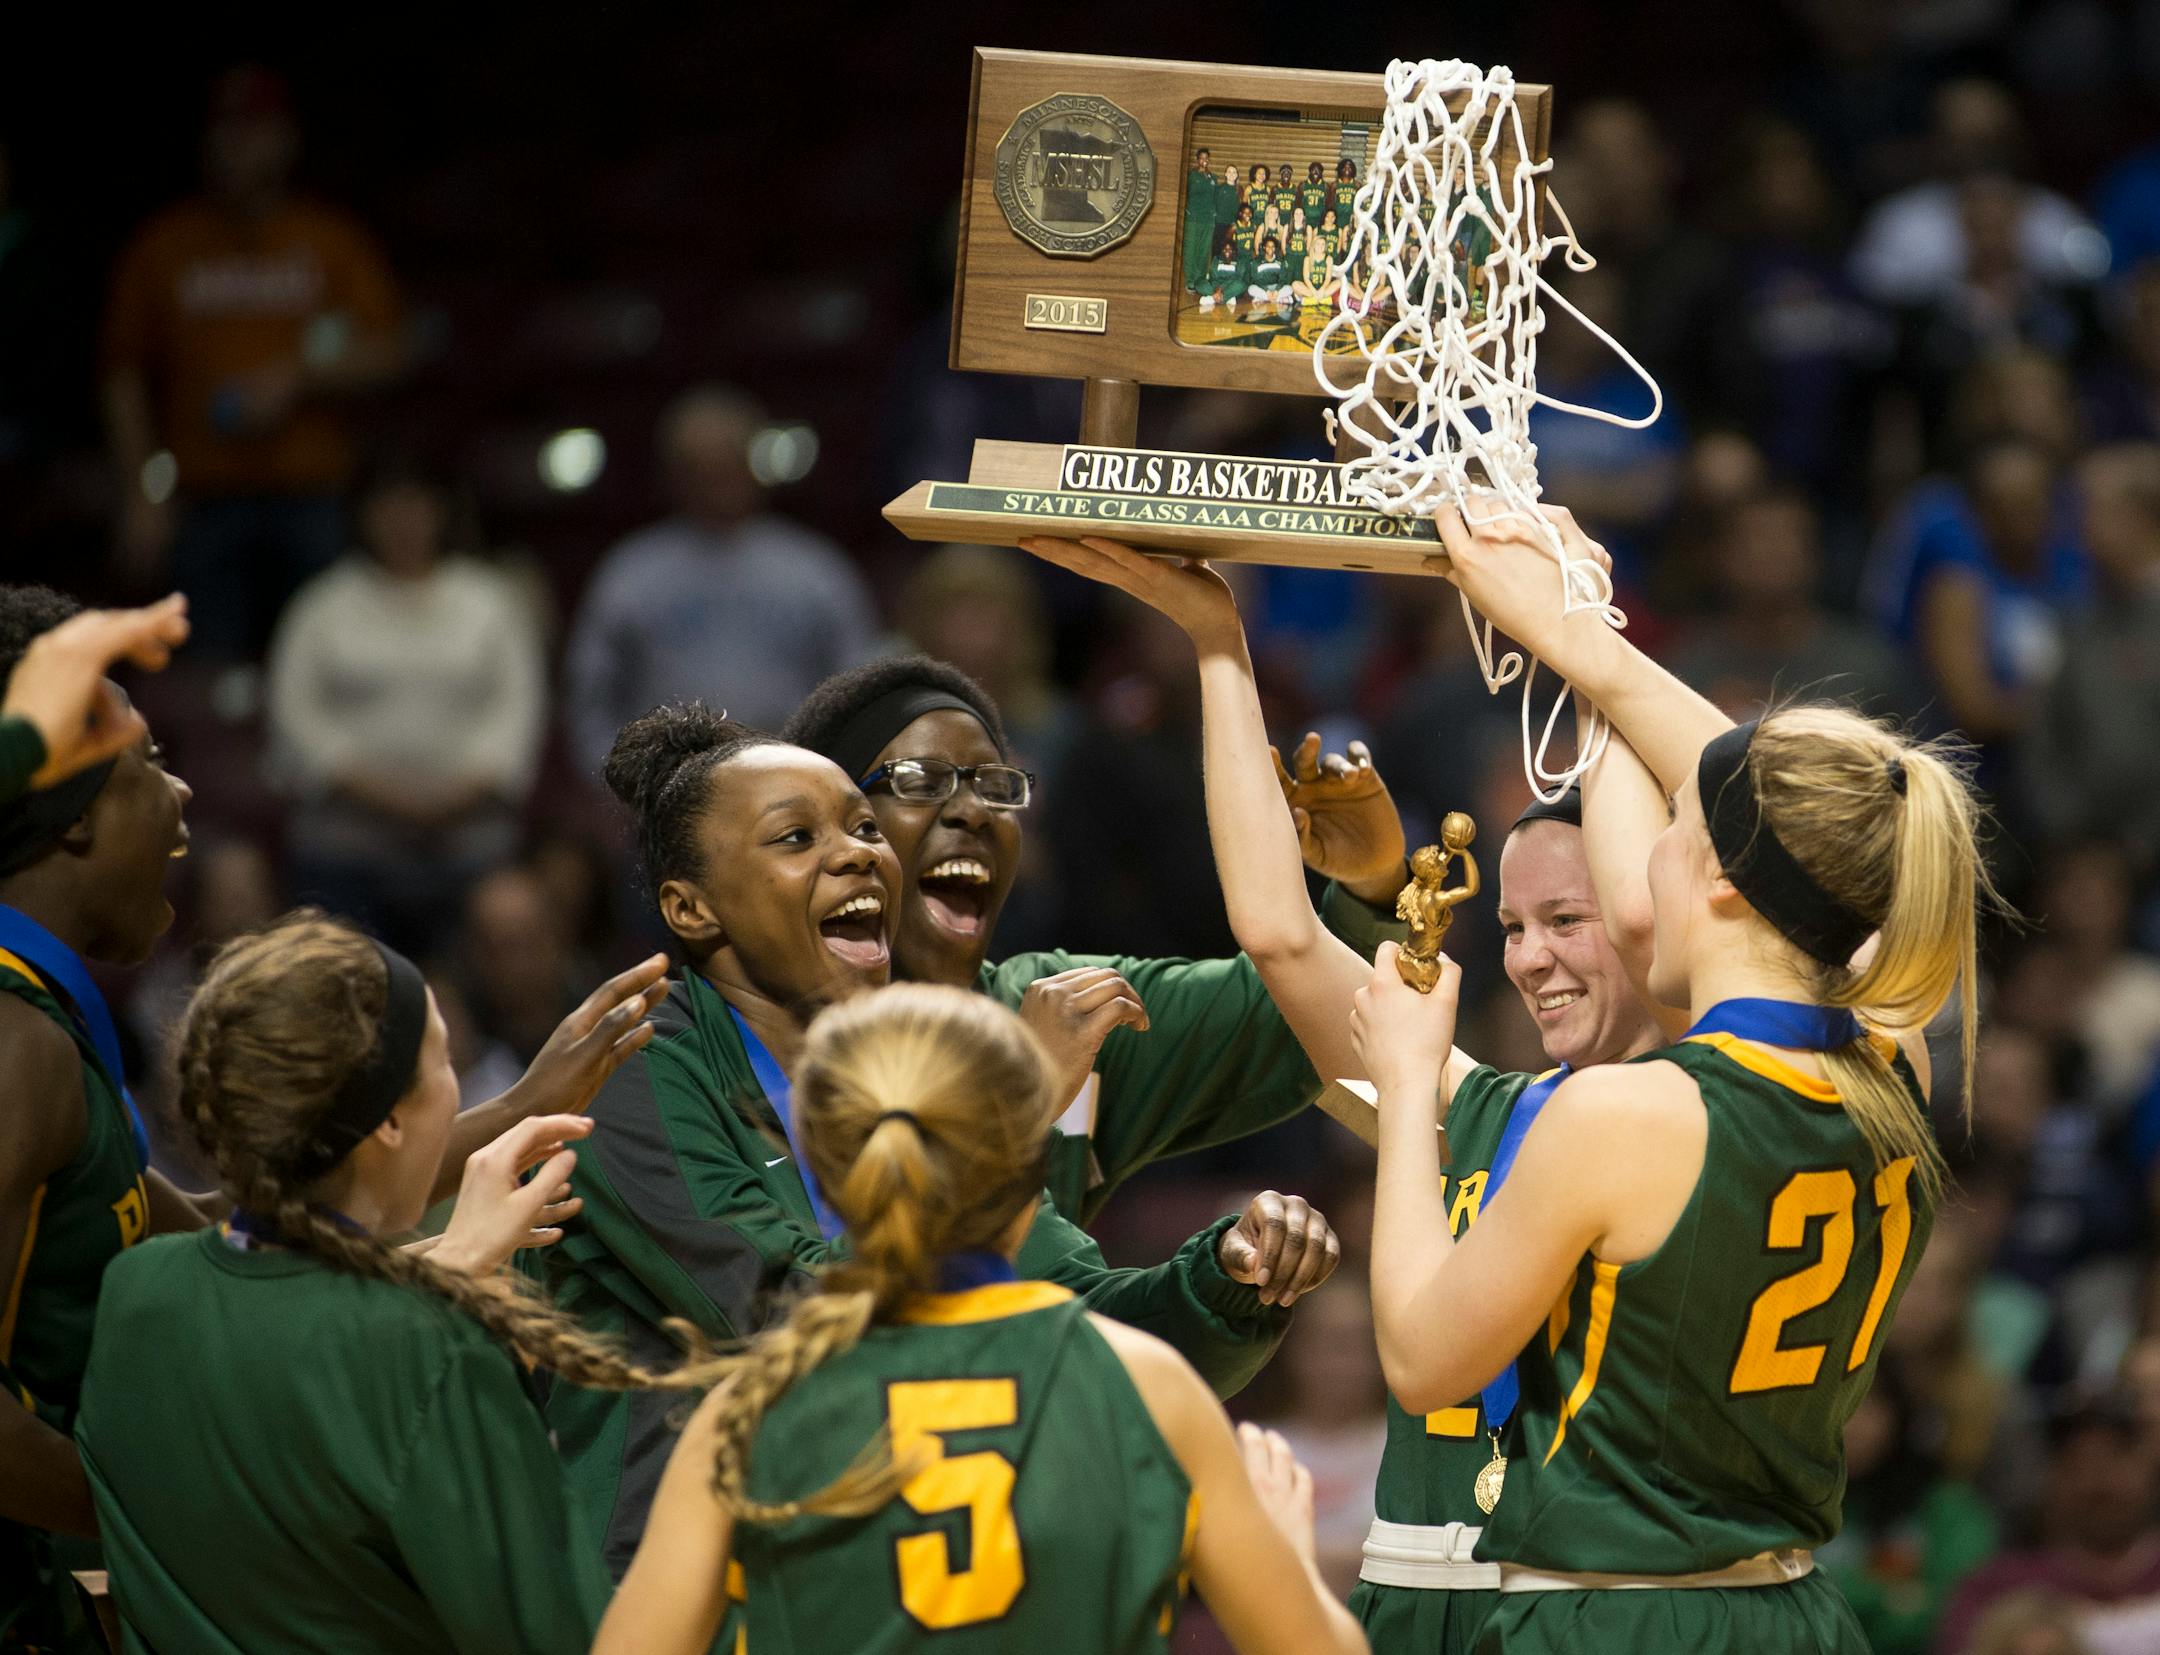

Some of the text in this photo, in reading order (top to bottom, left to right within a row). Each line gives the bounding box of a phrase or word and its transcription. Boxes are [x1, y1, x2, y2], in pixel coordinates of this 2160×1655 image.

[1022, 98, 1132, 136] MINNESOTA
[1029, 152, 1120, 191] MSHSL
[999, 160, 1017, 209] STATE
[1011, 208, 1050, 246] HIGH
[1051, 229, 1121, 251] SCHOOL
[1031, 300, 1099, 326] 2015
[1064, 451, 1368, 508] GIRLS BASKETBAL
[1003, 493, 1417, 537] STATE CLASS AAA CHAMPION
[1728, 1156, 1918, 1397] 21
[885, 1375, 1025, 1631] 5
